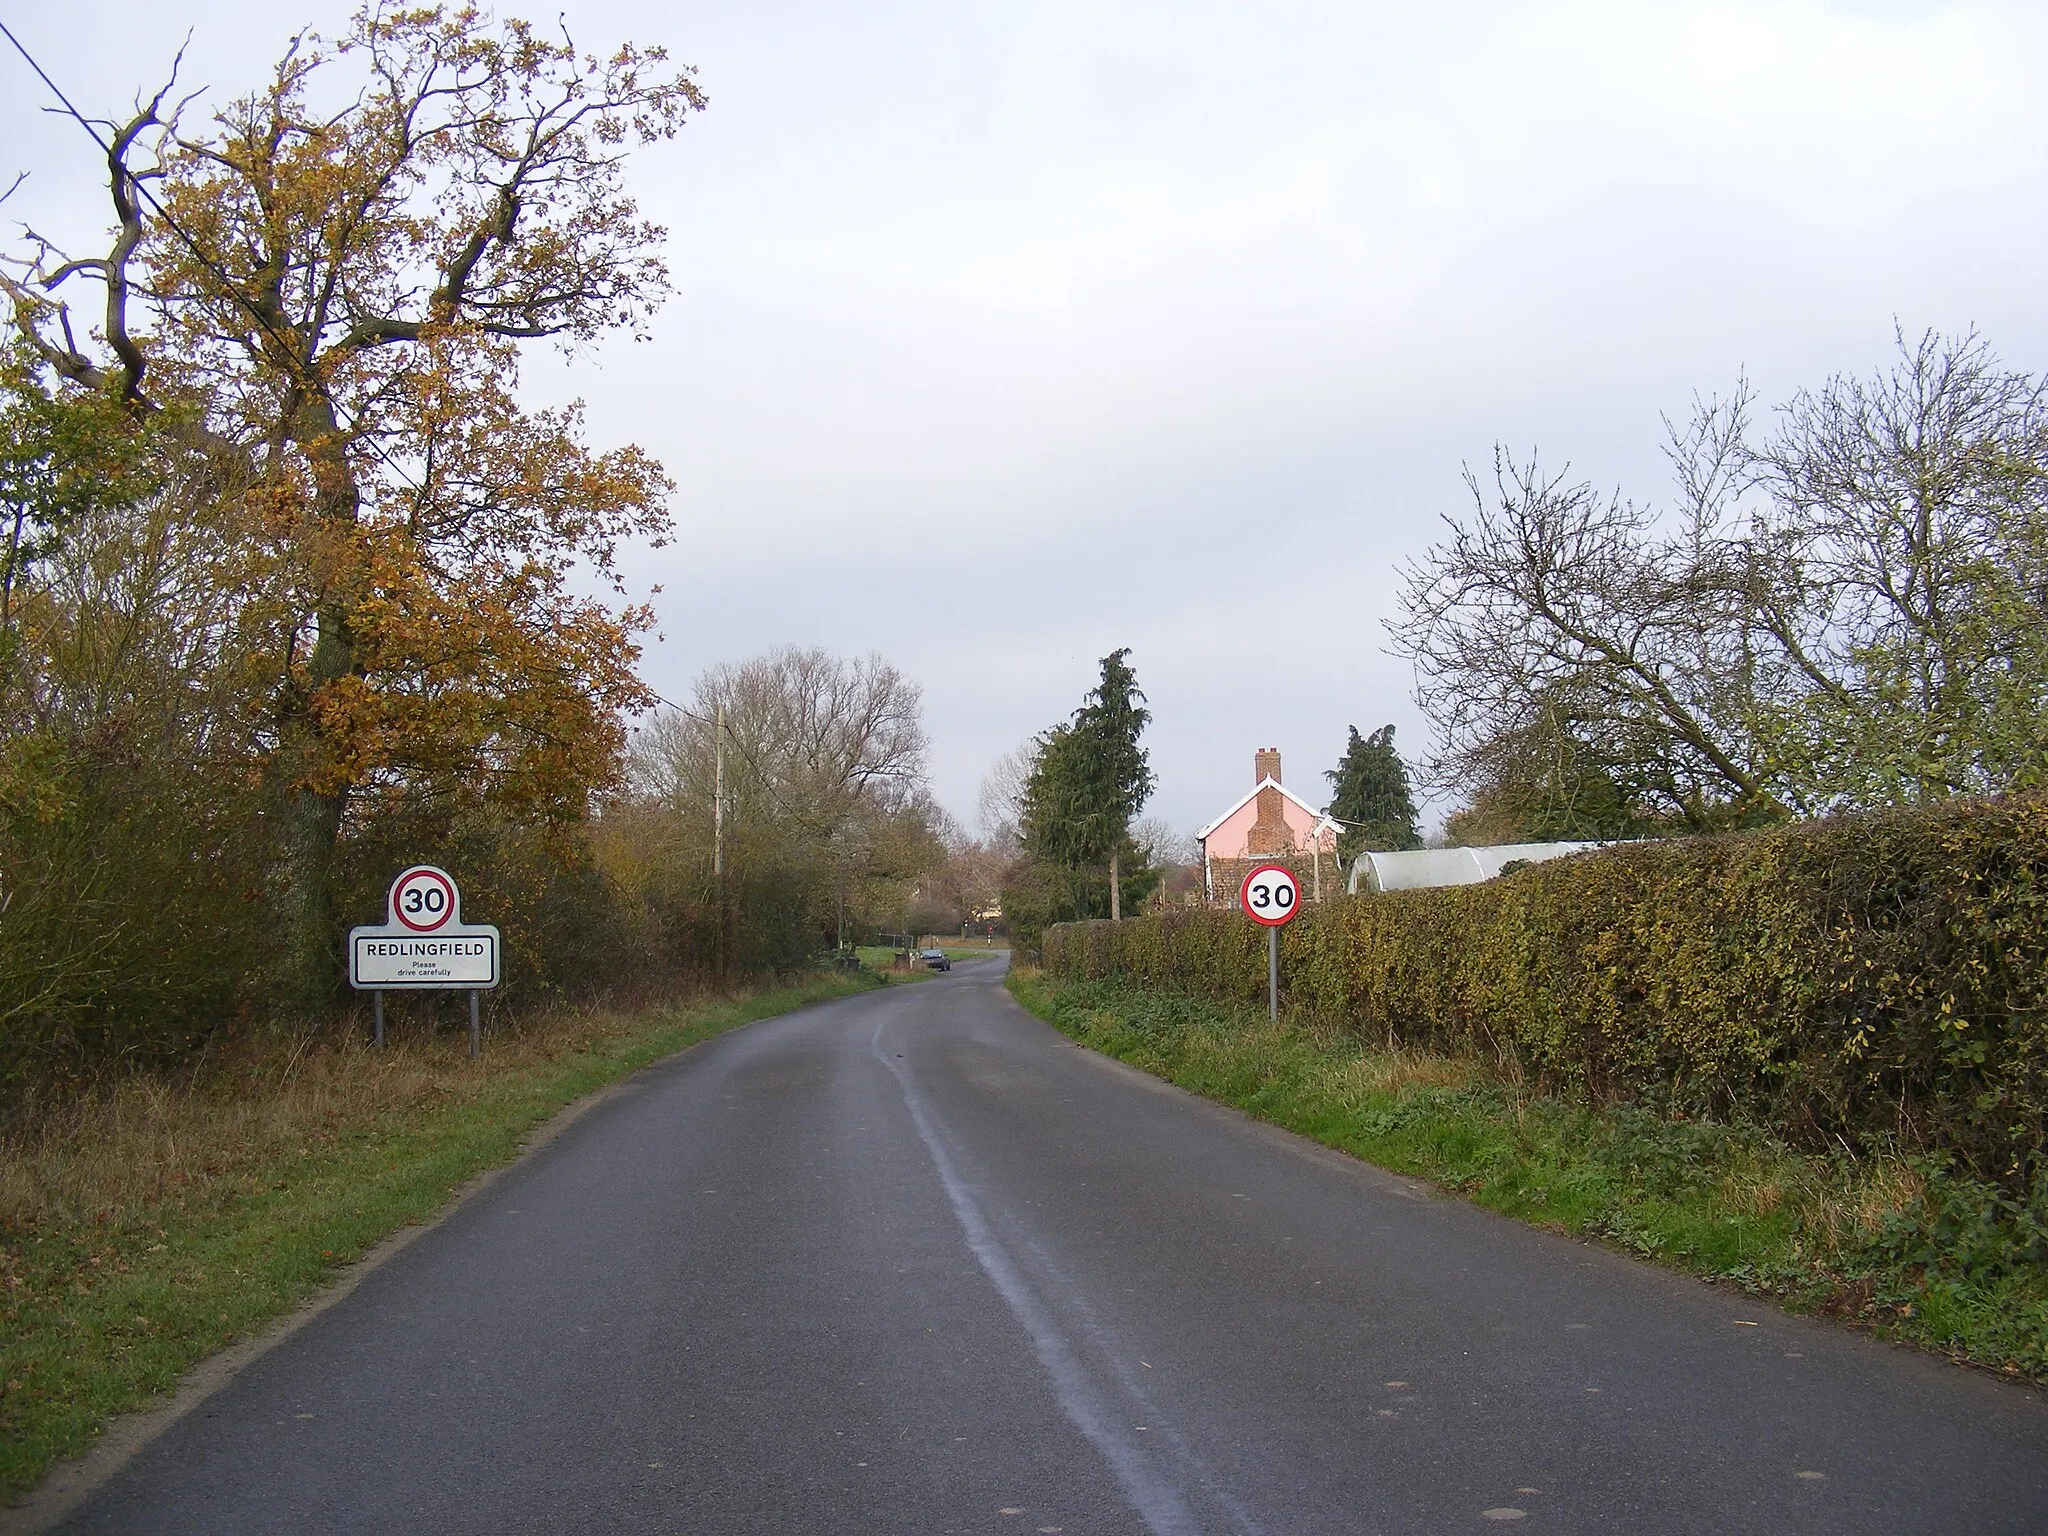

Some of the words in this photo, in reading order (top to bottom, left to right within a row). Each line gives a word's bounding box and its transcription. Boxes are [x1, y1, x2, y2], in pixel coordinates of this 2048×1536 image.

[404, 888, 444, 912] 30
[1252, 884, 1293, 908] 30
[367, 943, 484, 956] REDLINGFIELD
[418, 969, 451, 977] carefully
